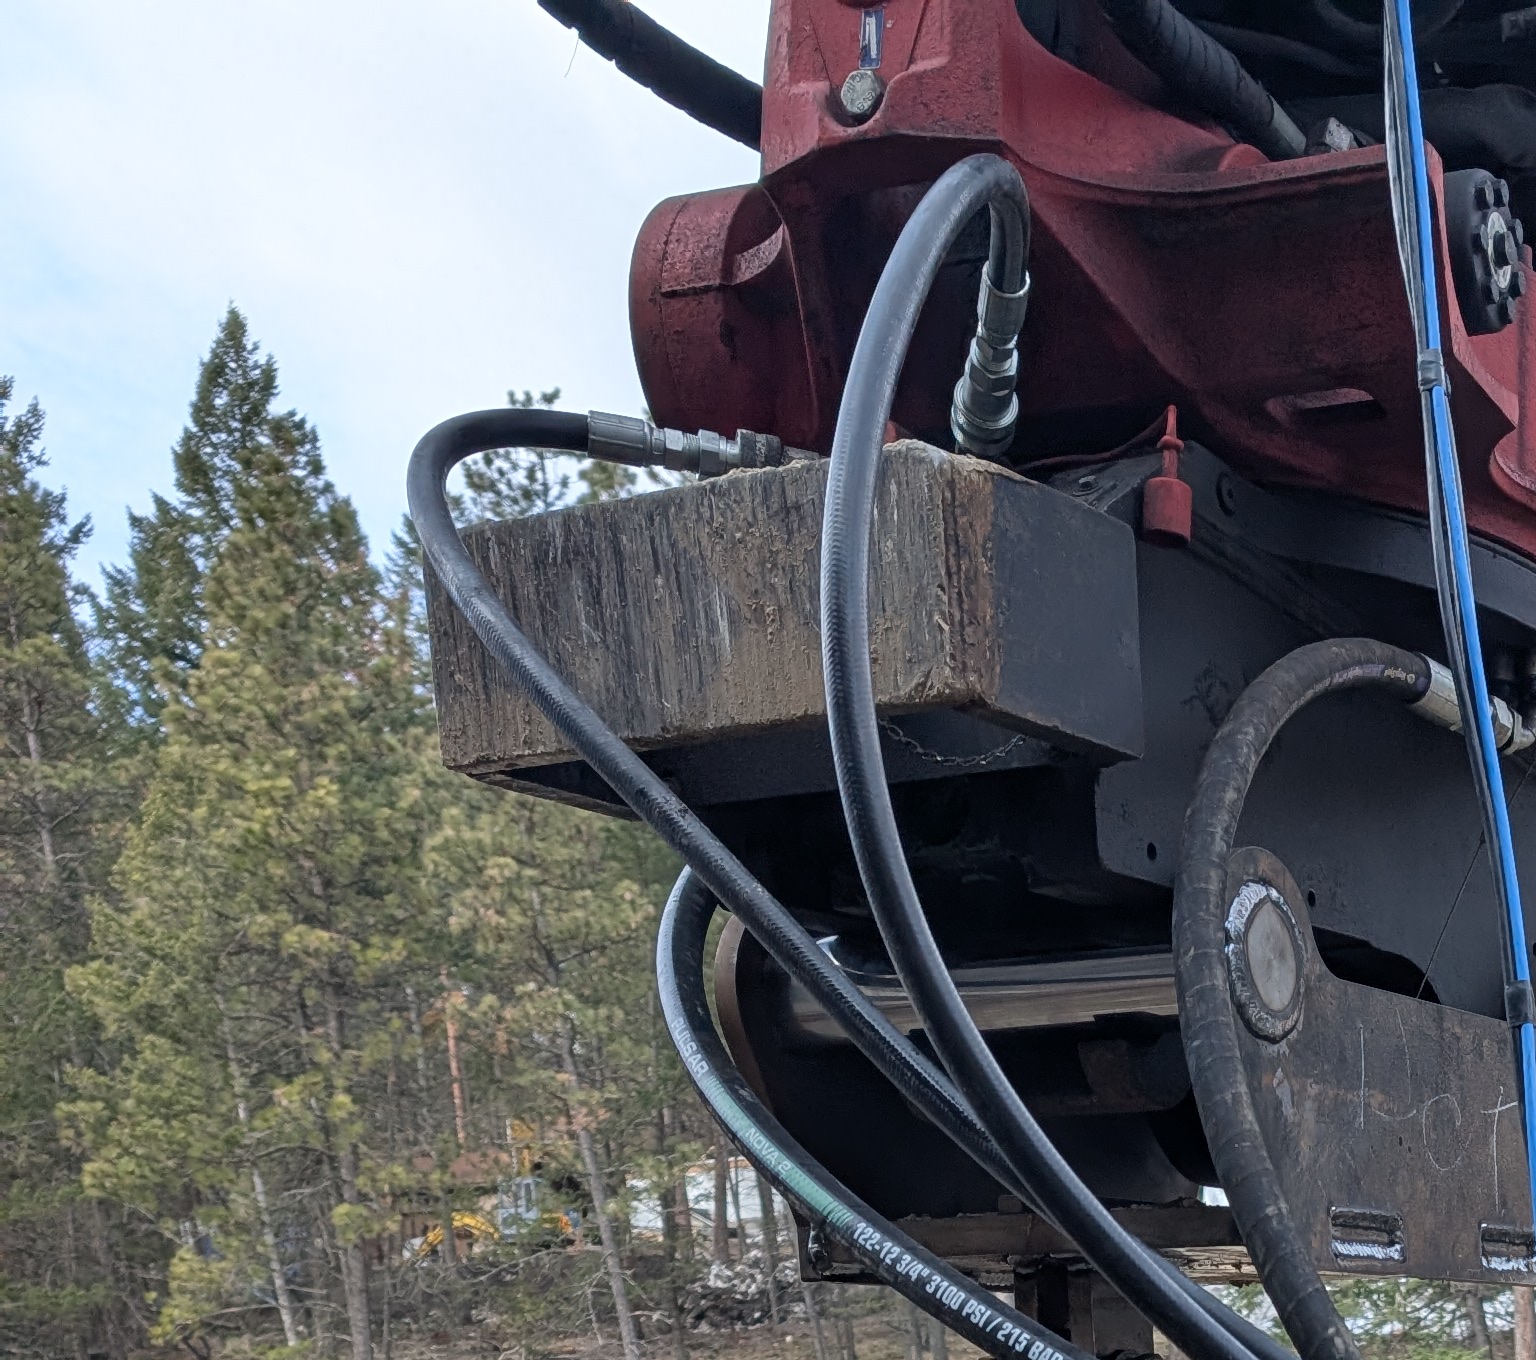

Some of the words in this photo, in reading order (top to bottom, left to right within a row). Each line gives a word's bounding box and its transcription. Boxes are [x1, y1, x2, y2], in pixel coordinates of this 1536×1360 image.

[671, 1018, 709, 1077] PULSAR
[745, 1127, 780, 1165] NOVA
[778, 1162, 792, 1175] 2
[852, 1221, 898, 1266] 122-12
[925, 1275, 965, 1310] 3100
[962, 1299, 991, 1329] PSI
[996, 1322, 1030, 1353] 215
